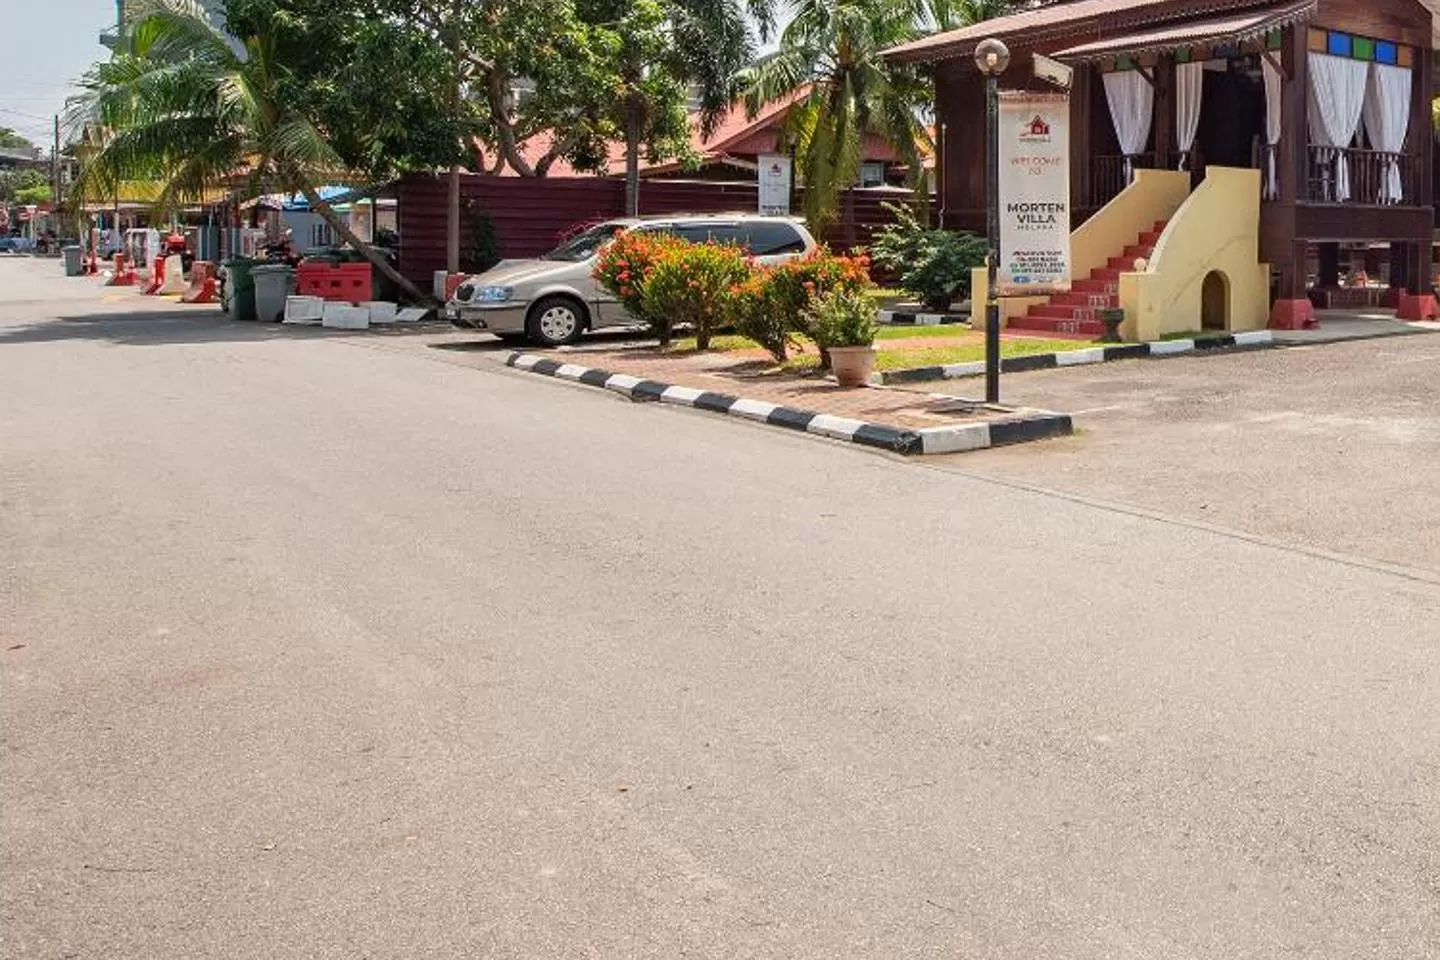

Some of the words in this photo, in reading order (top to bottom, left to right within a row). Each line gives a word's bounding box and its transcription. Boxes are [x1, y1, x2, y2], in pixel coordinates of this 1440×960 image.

[1010, 156, 1061, 165] WELCOME
[1007, 203, 1064, 212] MORTEN
[1017, 214, 1056, 223] VILLA
